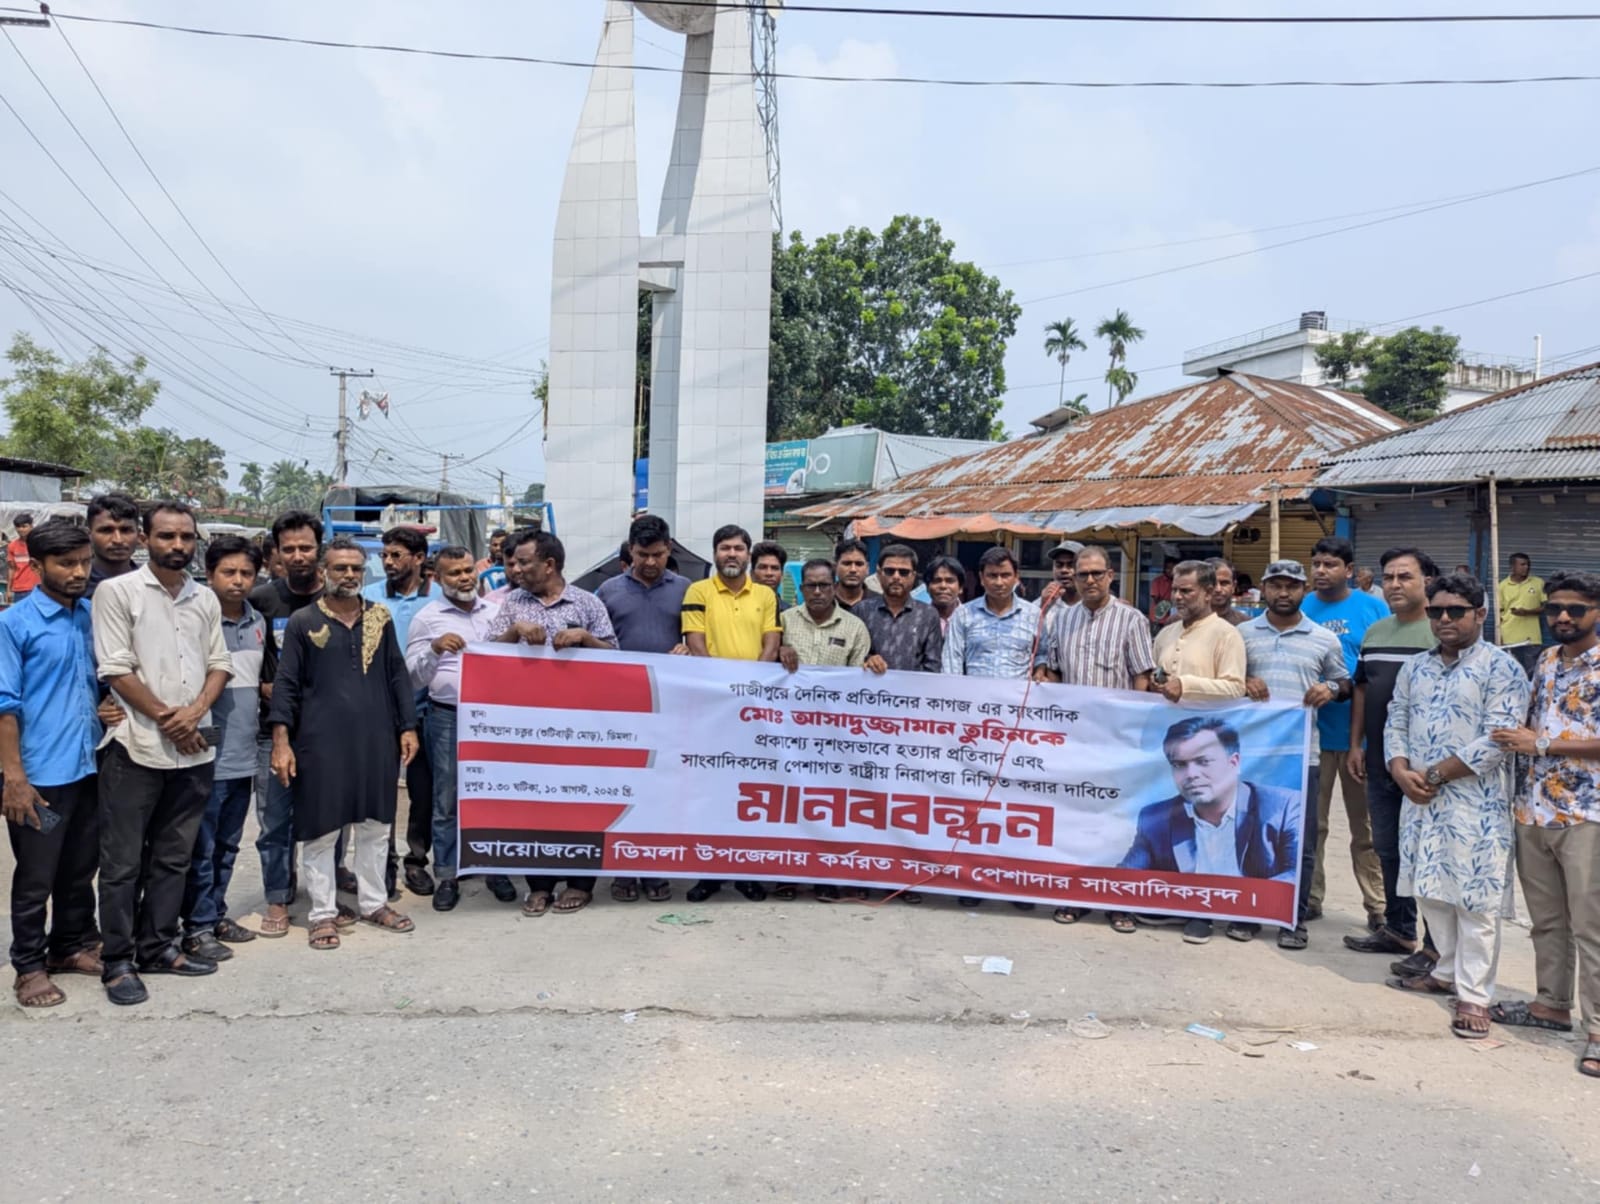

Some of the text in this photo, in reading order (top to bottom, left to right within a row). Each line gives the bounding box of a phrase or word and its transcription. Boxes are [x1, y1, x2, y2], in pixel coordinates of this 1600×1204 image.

[729, 680, 1080, 723] গাজীপুরে দৈনিক প্রতিদিনের কাগজ এর সাংবাদিক
[739, 706, 1067, 746] মোঃ আসাদুজ্জামান তুহিনকে
[755, 733, 1045, 771] প্রকাশ্যে নৃশংসভাবে হত্যার প্রতিবাদ এবং
[545, 784, 557, 794] ১০
[681, 751, 1121, 800] সাংবাদিকদের পেশাগত রাষ্ট্রীয় নিরাপত্তা নিশ্চিত করার দাবিতে
[737, 782, 1055, 846] মানববন্ধন
[612, 840, 686, 862] ডিমলা
[696, 843, 810, 867] উপজেলায়
[818, 850, 893, 872] কর্মরত
[901, 858, 961, 881] সকল
[971, 865, 1069, 890] পেশাদার
[1080, 877, 1241, 910] সাংবাদিকবৃন্দ
